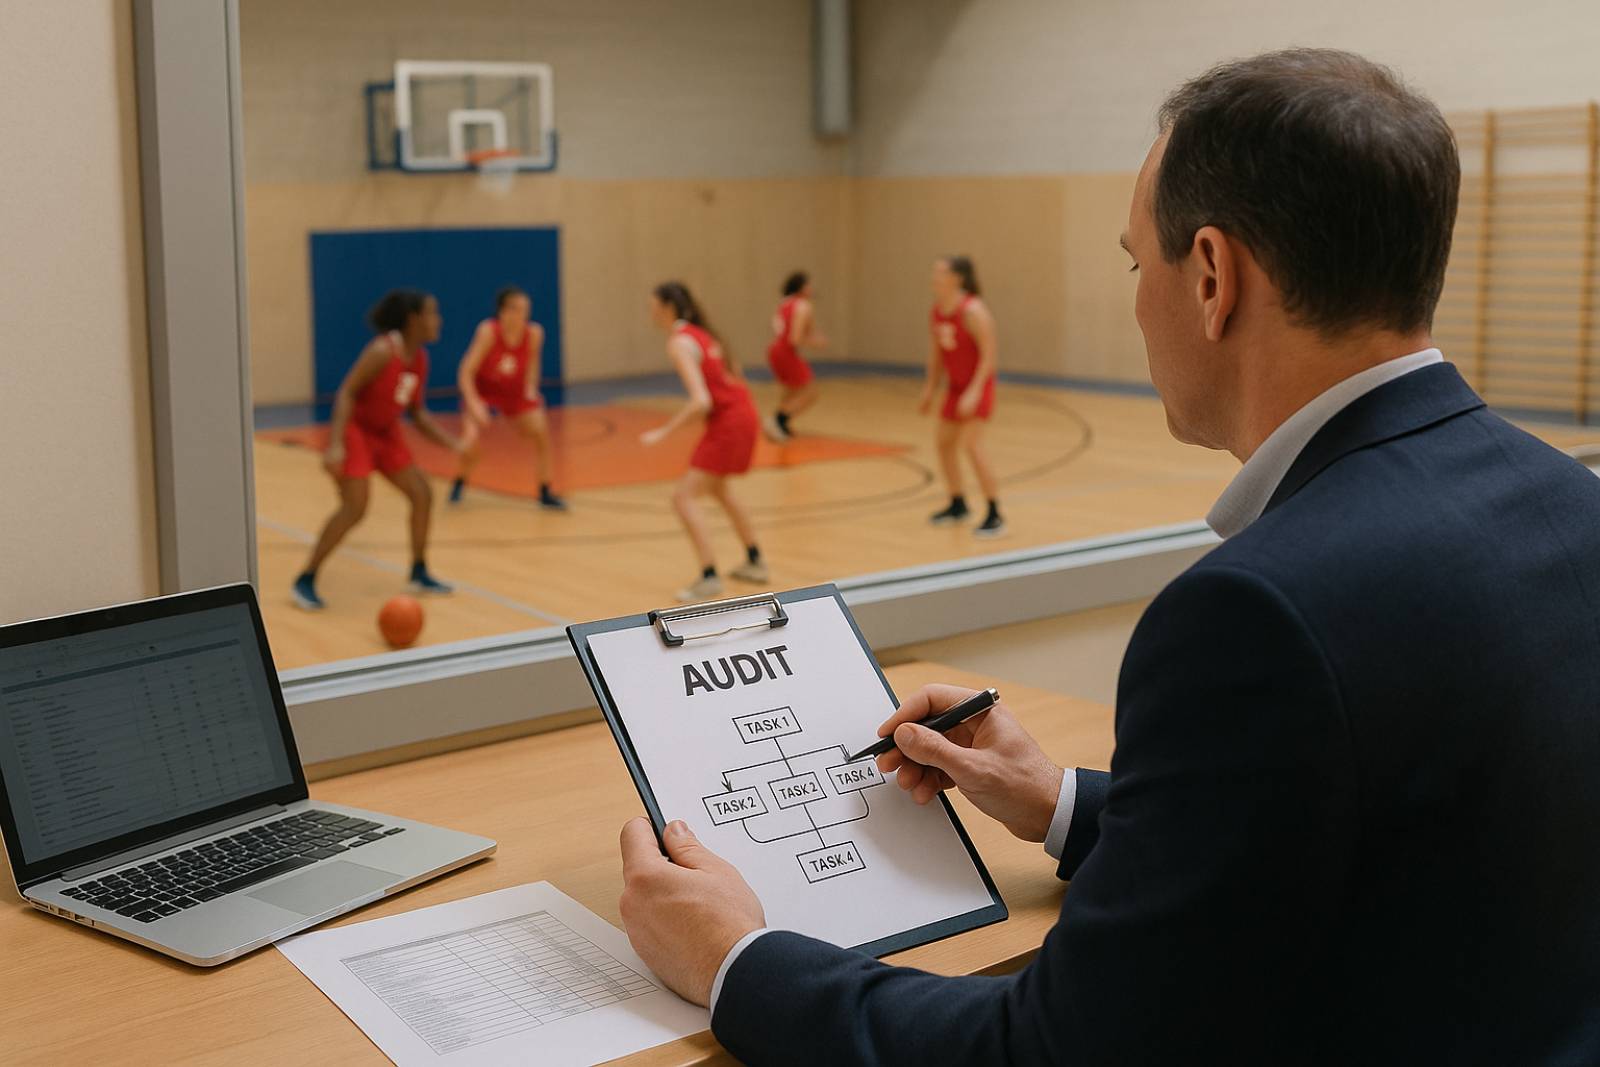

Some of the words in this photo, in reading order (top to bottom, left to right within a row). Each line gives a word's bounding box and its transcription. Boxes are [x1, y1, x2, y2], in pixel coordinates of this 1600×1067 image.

[682, 644, 794, 696] AUDIT
[744, 717, 783, 734] TASK
[781, 716, 790, 727] 1
[836, 769, 868, 784] TASK
[866, 766, 875, 779] 4
[779, 783, 811, 799] TASK
[808, 781, 818, 793] 2
[713, 798, 750, 815] TASK
[747, 796, 757, 808] 2
[845, 850, 855, 863] 4
